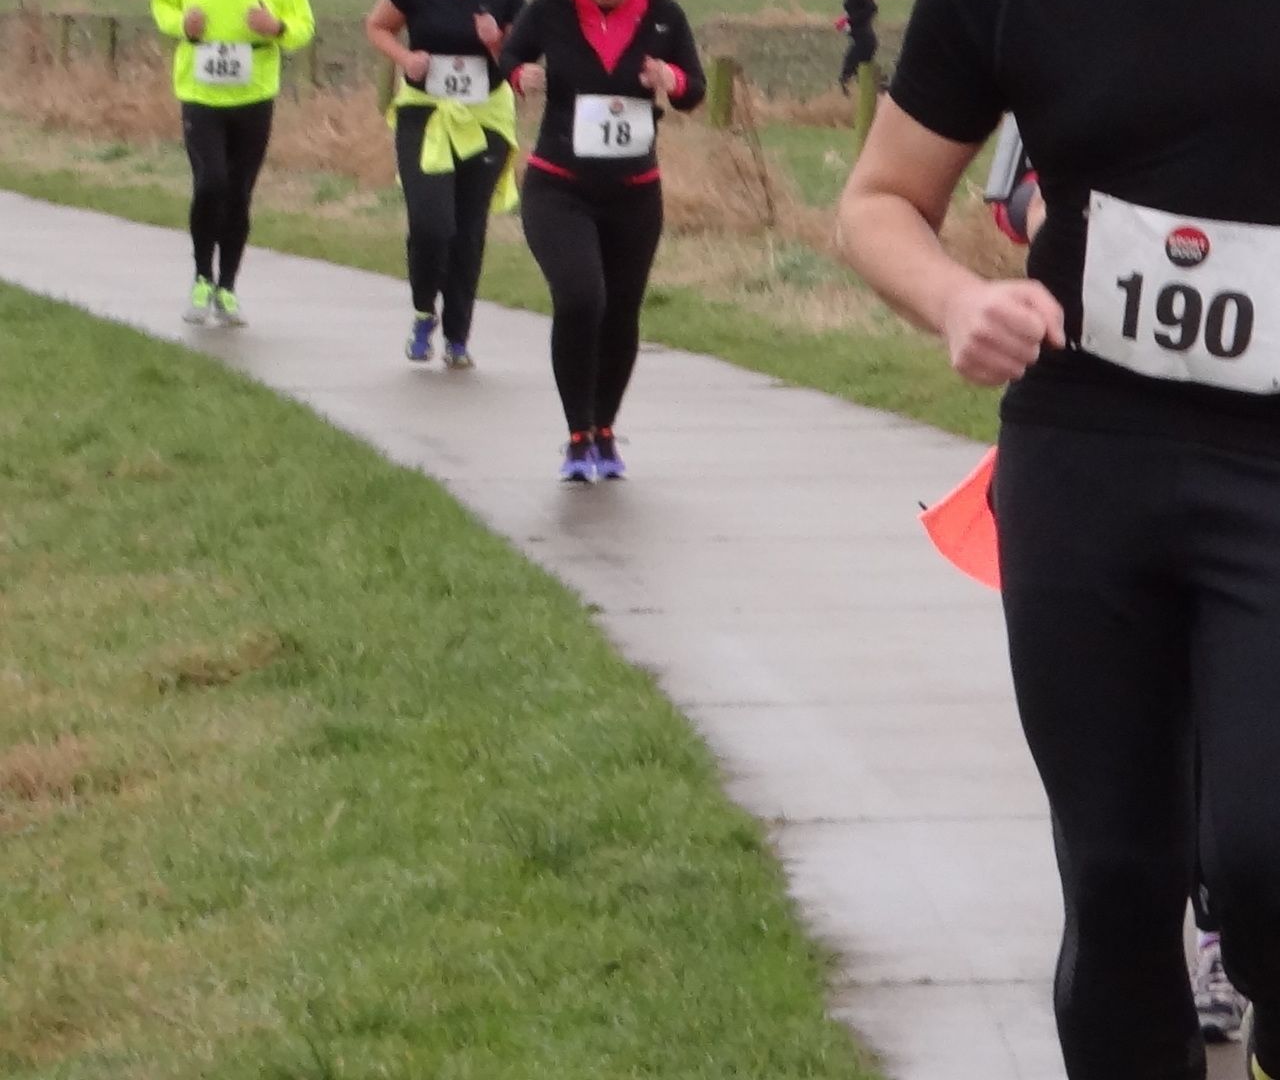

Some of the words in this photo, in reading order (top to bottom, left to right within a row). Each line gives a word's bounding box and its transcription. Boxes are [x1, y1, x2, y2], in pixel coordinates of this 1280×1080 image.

[204, 58, 241, 77] 482
[444, 74, 472, 95] 92
[600, 121, 632, 146] 18
[1116, 271, 1254, 359] 190
